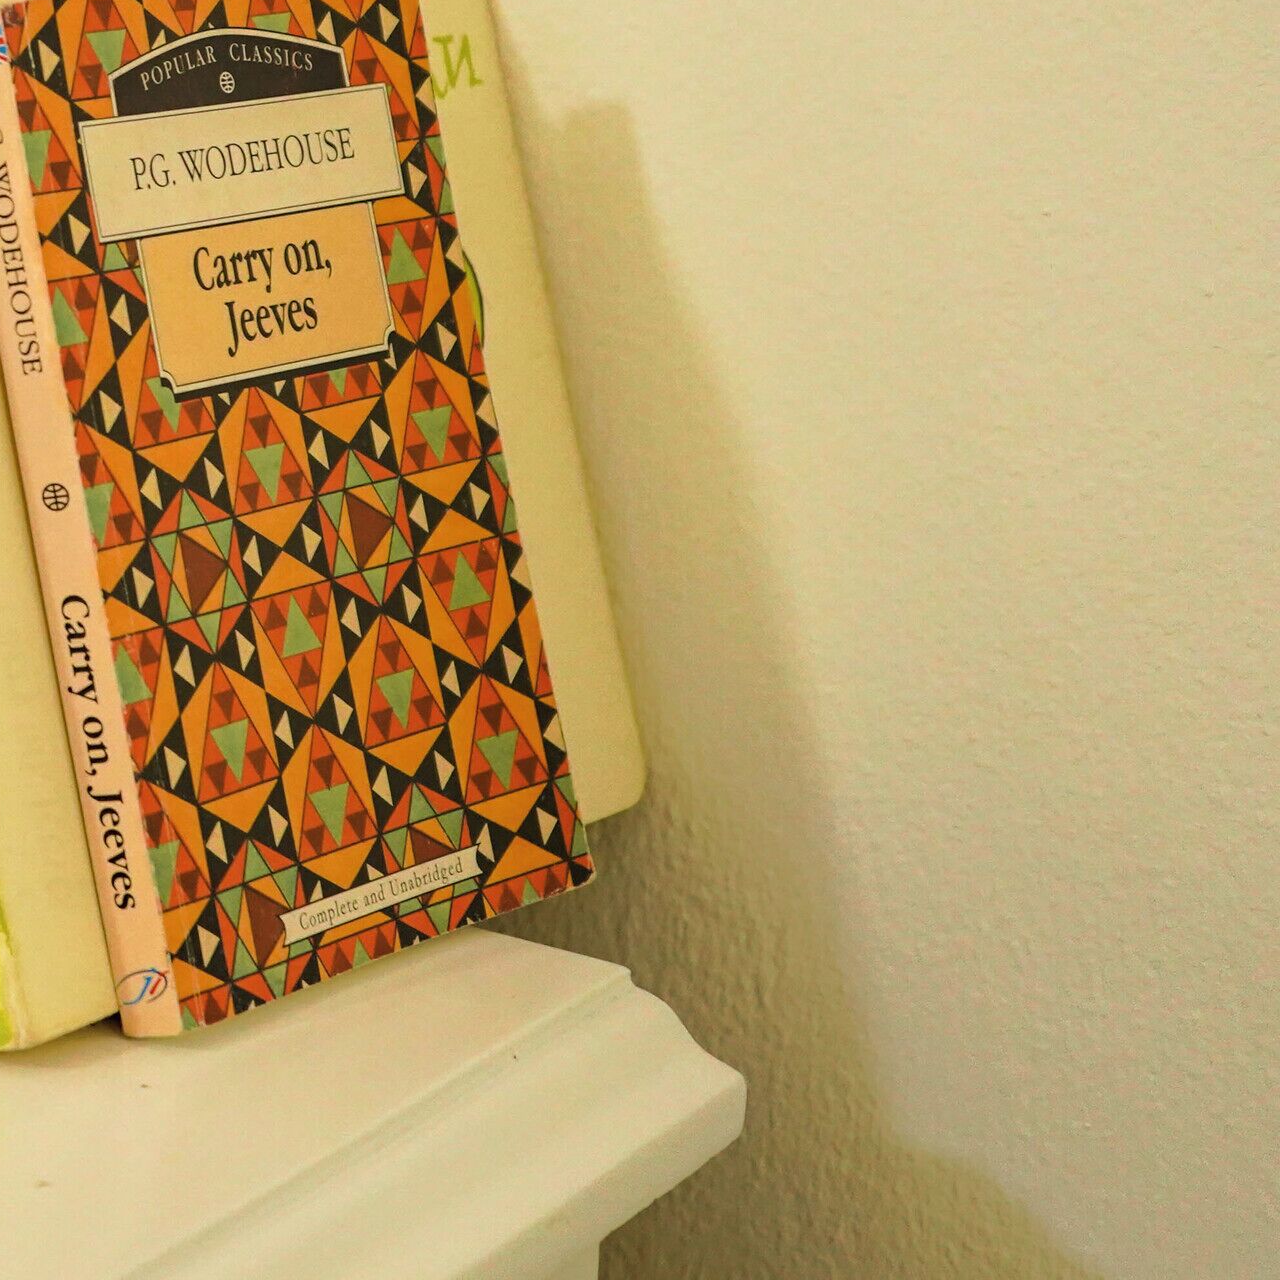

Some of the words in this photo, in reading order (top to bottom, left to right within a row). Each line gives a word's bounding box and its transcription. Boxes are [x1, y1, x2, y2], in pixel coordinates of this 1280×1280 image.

[140, 45, 218, 91] POPULAR
[229, 42, 315, 73] CLASSICS
[132, 155, 177, 192] P.G.
[179, 128, 355, 183] WODEHOUSE
[193, 247, 274, 294] Carry
[283, 236, 333, 279] on,
[225, 294, 319, 358] Jeeves
[60, 594, 99, 704] Carry
[83, 715, 109, 777] on,
[88, 785, 136, 910] Jeeves
[298, 894, 359, 931] Complete
[363, 882, 387, 906] and
[388, 857, 465, 899] Unabridged
